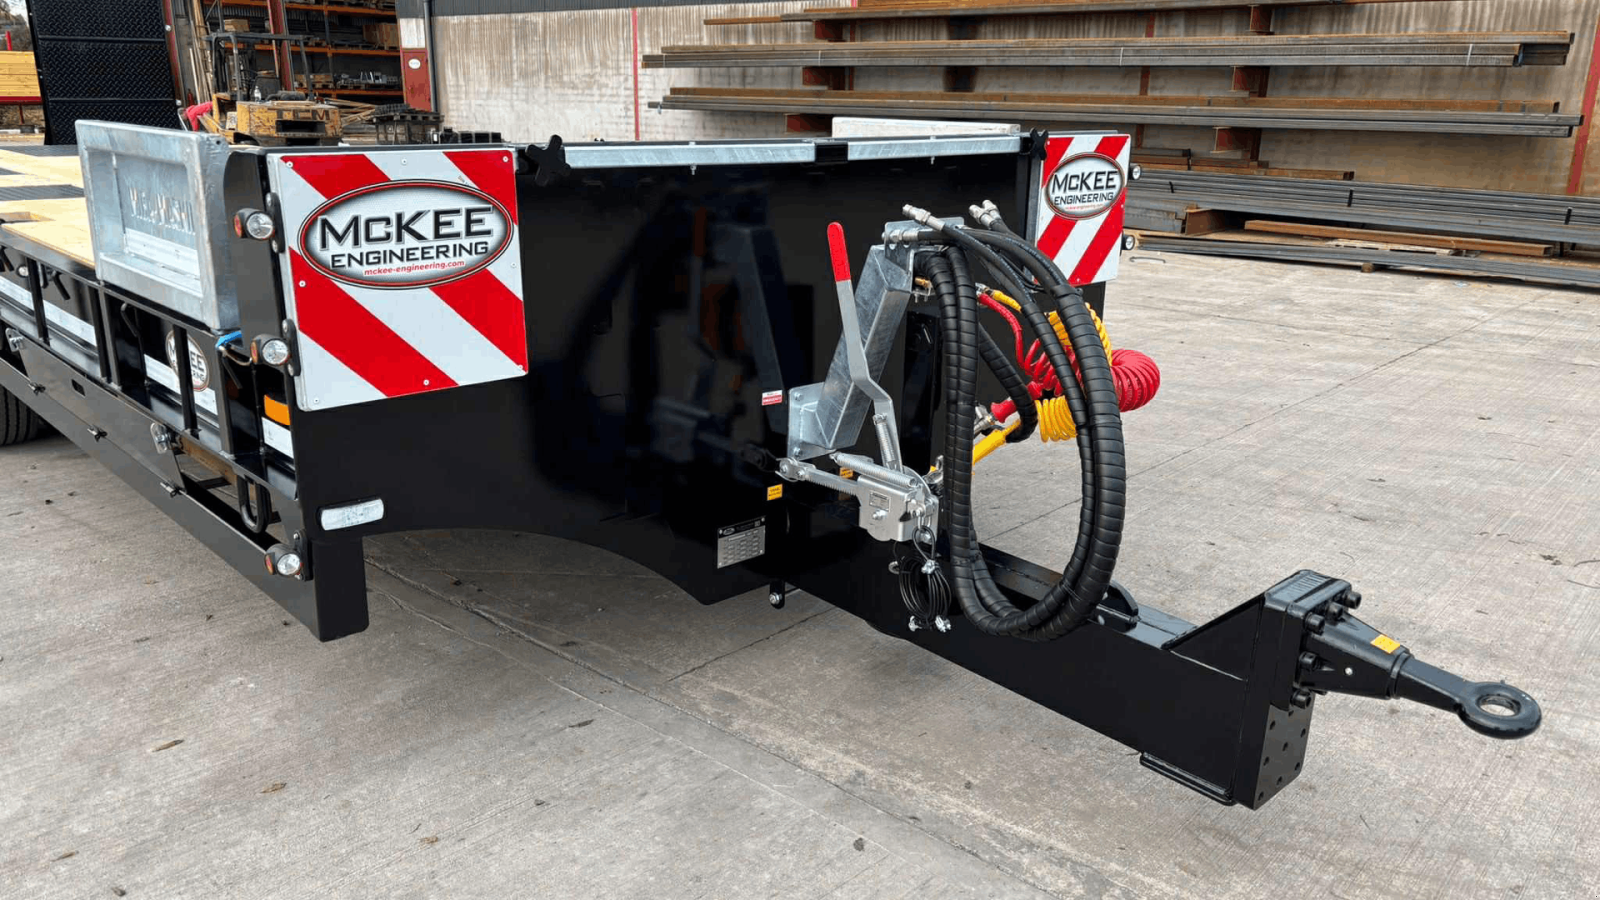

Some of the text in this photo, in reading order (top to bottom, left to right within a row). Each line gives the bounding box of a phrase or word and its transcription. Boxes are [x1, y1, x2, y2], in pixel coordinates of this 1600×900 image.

[1054, 192, 1114, 205] ENGINEERING
[331, 241, 489, 269] ENGINEERING
[364, 260, 465, 276] mckee-engineering.com
